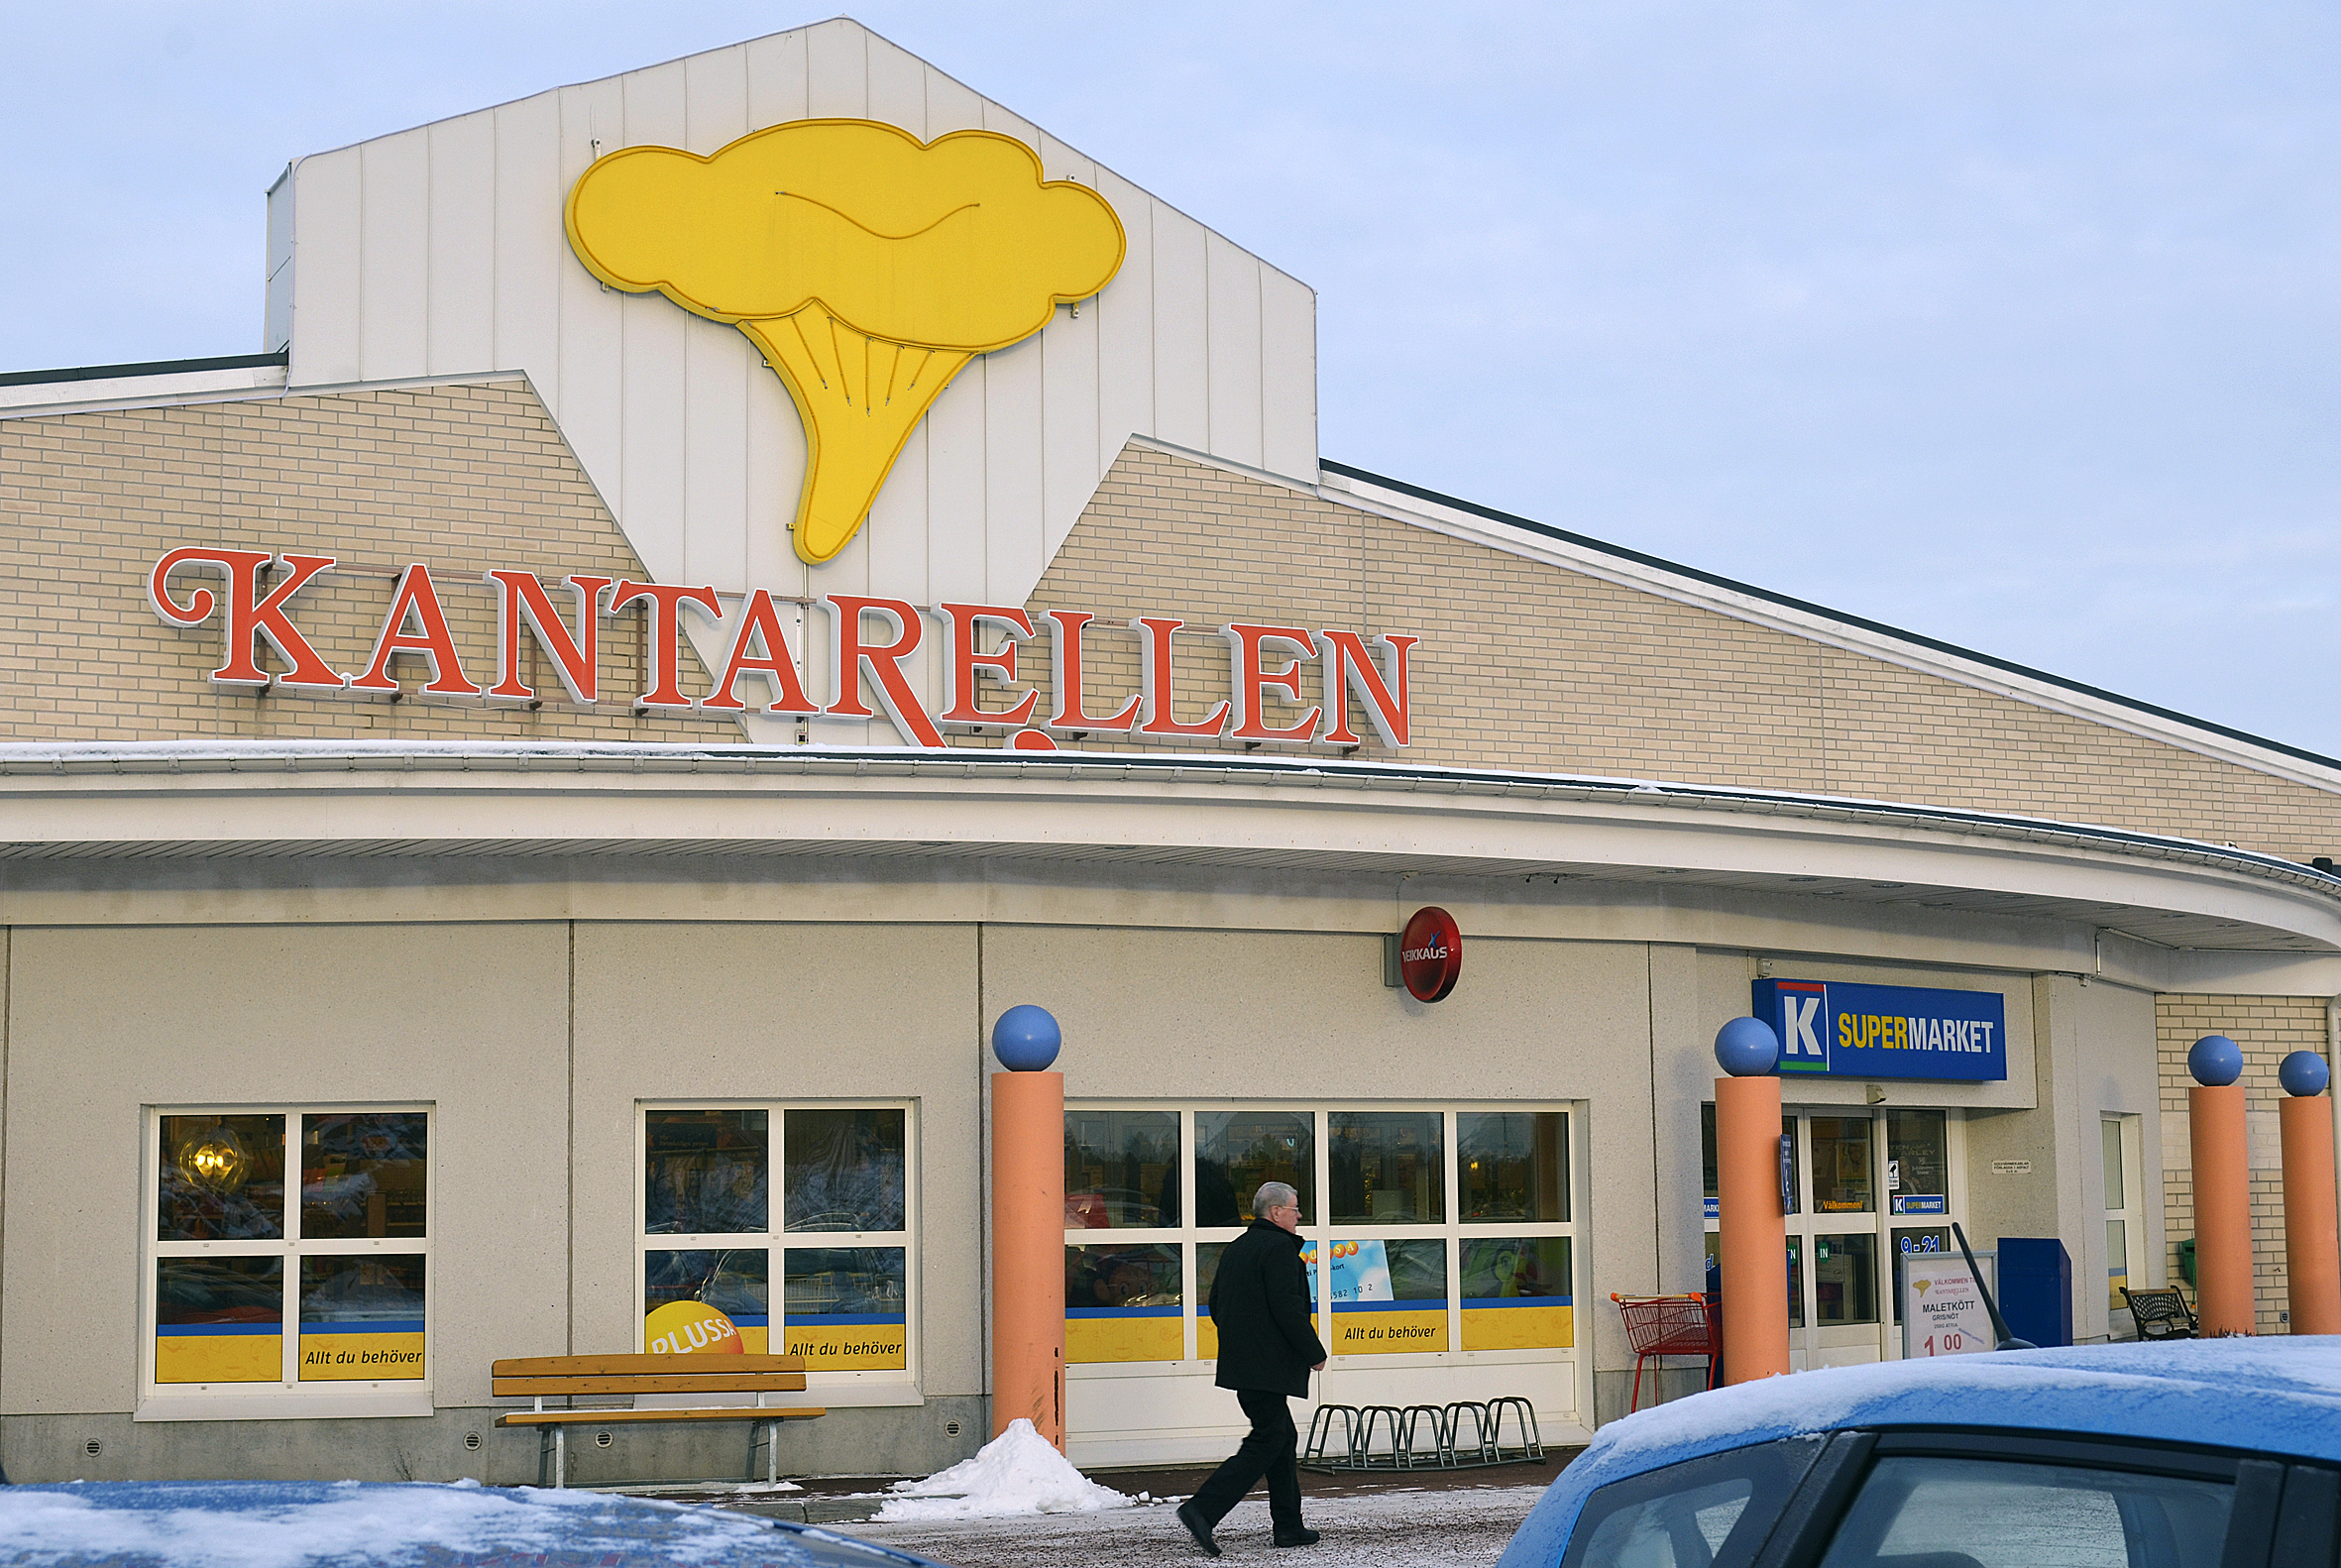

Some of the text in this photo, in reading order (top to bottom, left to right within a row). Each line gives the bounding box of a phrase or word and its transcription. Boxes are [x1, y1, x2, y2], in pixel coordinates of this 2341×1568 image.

[147, 545, 1420, 750] KANTARELLEN
[1401, 946, 1448, 962] VEIKKAUS
[1783, 996, 1994, 1057] K SUPERMARKET
[1906, 1200, 1942, 1209] SUPERMARKET
[1820, 1248, 1829, 1259] IN
[1934, 1277, 1968, 1286] VÄLKOMMEN
[1923, 1299, 1974, 1313] MALETKÖTT
[651, 1318, 736, 1354] PLUSSA
[1344, 1325, 1436, 1340] Allt du behöver
[790, 1340, 902, 1356] Allt du behöver
[1944, 1333, 1961, 1351] 00
[305, 1349, 422, 1365] Allt du behöver
